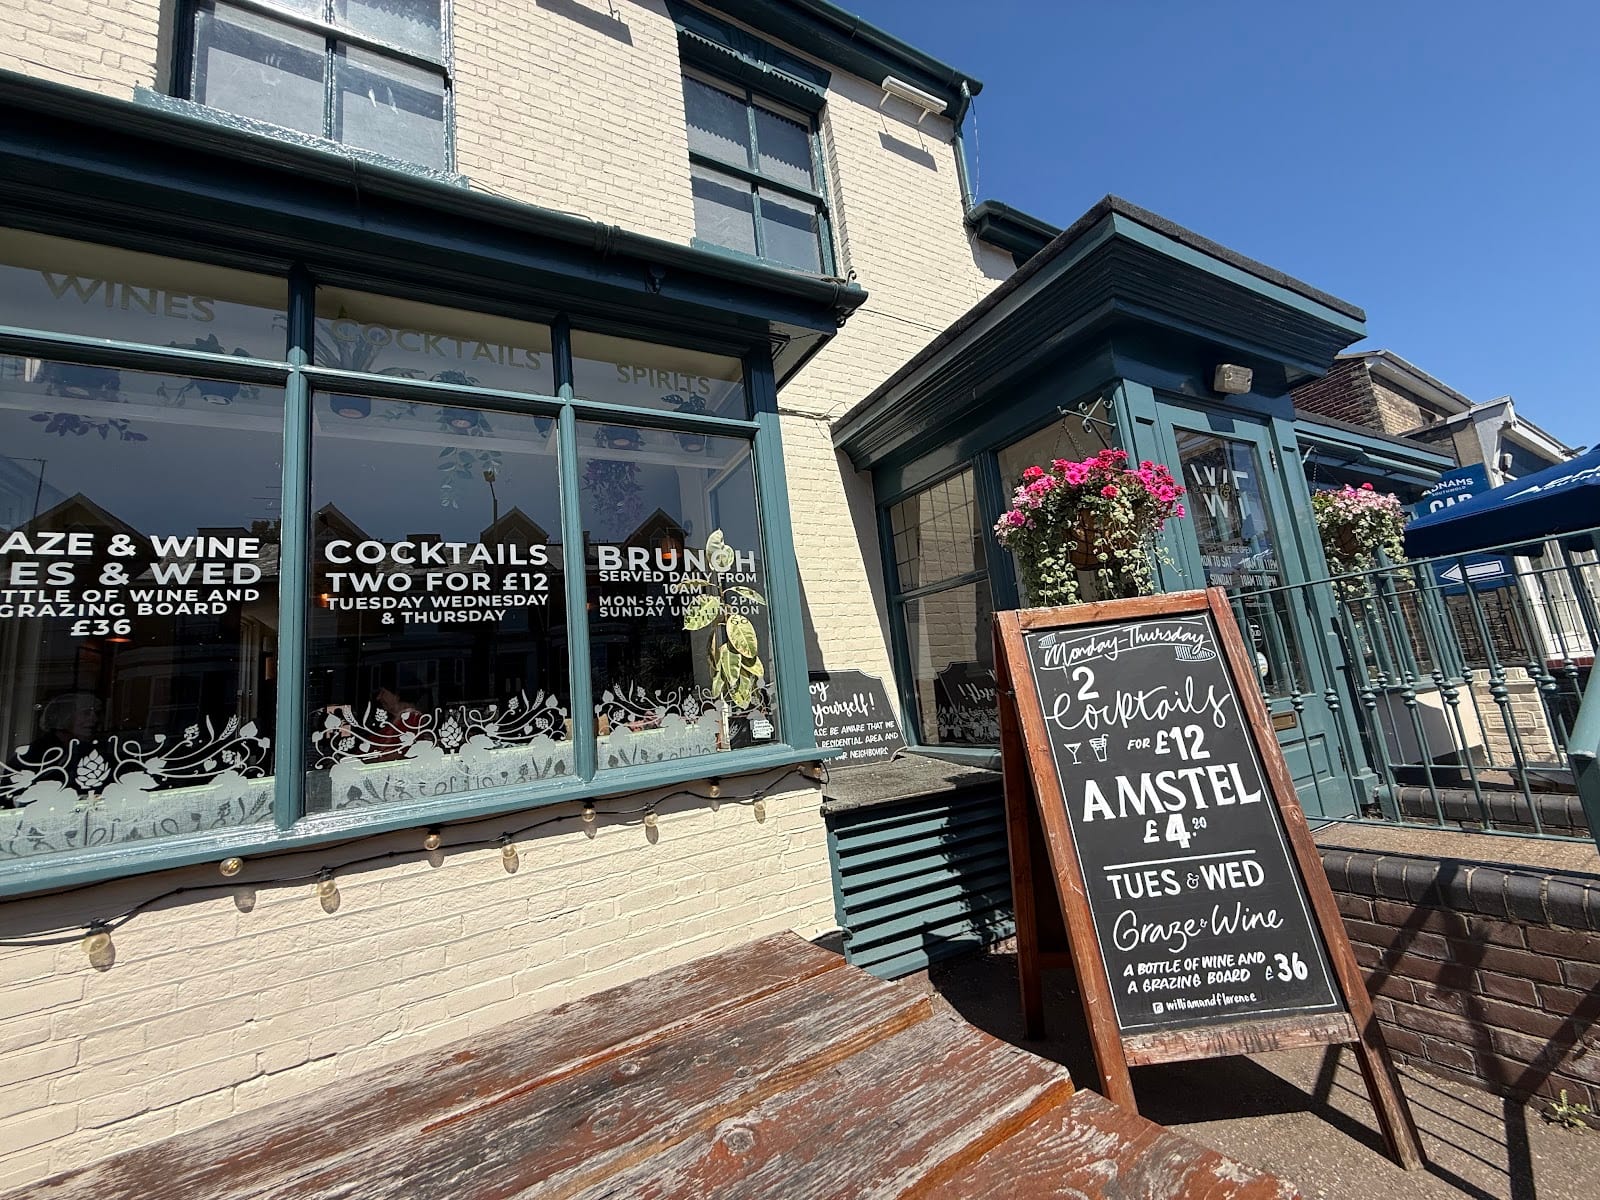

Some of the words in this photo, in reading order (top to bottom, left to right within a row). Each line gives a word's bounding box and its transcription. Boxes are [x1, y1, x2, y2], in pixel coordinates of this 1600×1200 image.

[41, 271, 216, 322] WINES
[331, 318, 542, 370] COCKTAILS
[616, 363, 711, 395] SPIRITS
[0, 531, 94, 556] AZE
[107, 534, 136, 557] &
[150, 536, 260, 559] WINE
[324, 540, 548, 565] COCKTAILS
[597, 545, 756, 573] BRUNCH
[1221, 556, 1232, 568] SAT
[1264, 559, 1278, 570] 11PM
[10, 562, 75, 585] ES
[99, 563, 130, 585] &
[150, 563, 262, 585] WED
[325, 572, 412, 593] TWO
[427, 572, 491, 592] FOR
[502, 573, 549, 591] £12
[600, 570, 664, 582] SERVED
[669, 571, 713, 583] DAILY
[717, 572, 757, 582] FROM
[1210, 574, 1233, 585] SUNDAY
[1240, 575, 1256, 586] 10AM
[1, 589, 70, 604] TTLE
[82, 589, 119, 603] OF
[129, 589, 198, 602] WINE
[207, 589, 260, 601] AND
[662, 583, 702, 595] 10AM
[0, 602, 126, 618] GRAZING
[137, 602, 228, 616] BOARD
[326, 597, 424, 610] TUESDAY
[430, 594, 549, 608] WEDNESDAY
[600, 596, 674, 606] MON-SAT
[731, 596, 759, 605] 2PM
[600, 606, 665, 617] SUNDAY
[381, 612, 395, 624] &
[401, 609, 507, 623] THURSDAY
[70, 619, 131, 637] £36
[1072, 666, 1099, 701] 2
[1044, 676, 1231, 729] Cocktails
[830, 727, 839, 735] BE
[841, 723, 865, 734] AWARE
[867, 721, 883, 730] THAT
[822, 737, 863, 747] RESIDENTIAL
[865, 734, 883, 743] AREA
[885, 732, 898, 740] AND
[1127, 738, 1151, 751] FOR
[1155, 724, 1211, 761] £12
[850, 747, 888, 758] NEIGHBOURS
[1082, 763, 1262, 822] AMSTEL
[1107, 869, 1181, 900] TUES
[1186, 873, 1199, 889] &
[1200, 860, 1265, 891] WED
[1113, 910, 1201, 953] Graze
[1200, 918, 1208, 928] &
[1211, 902, 1284, 936] Wine
[1123, 963, 1134, 977] A
[1138, 960, 1181, 976] BOTTLE
[1184, 957, 1200, 971] OF
[1202, 954, 1236, 970] WINE
[1238, 952, 1266, 966] AND
[1127, 980, 1138, 994] A
[1142, 975, 1201, 993] GRAZING
[1207, 968, 1250, 985] BOARD
[1166, 993, 1257, 1011] williamandflorence
